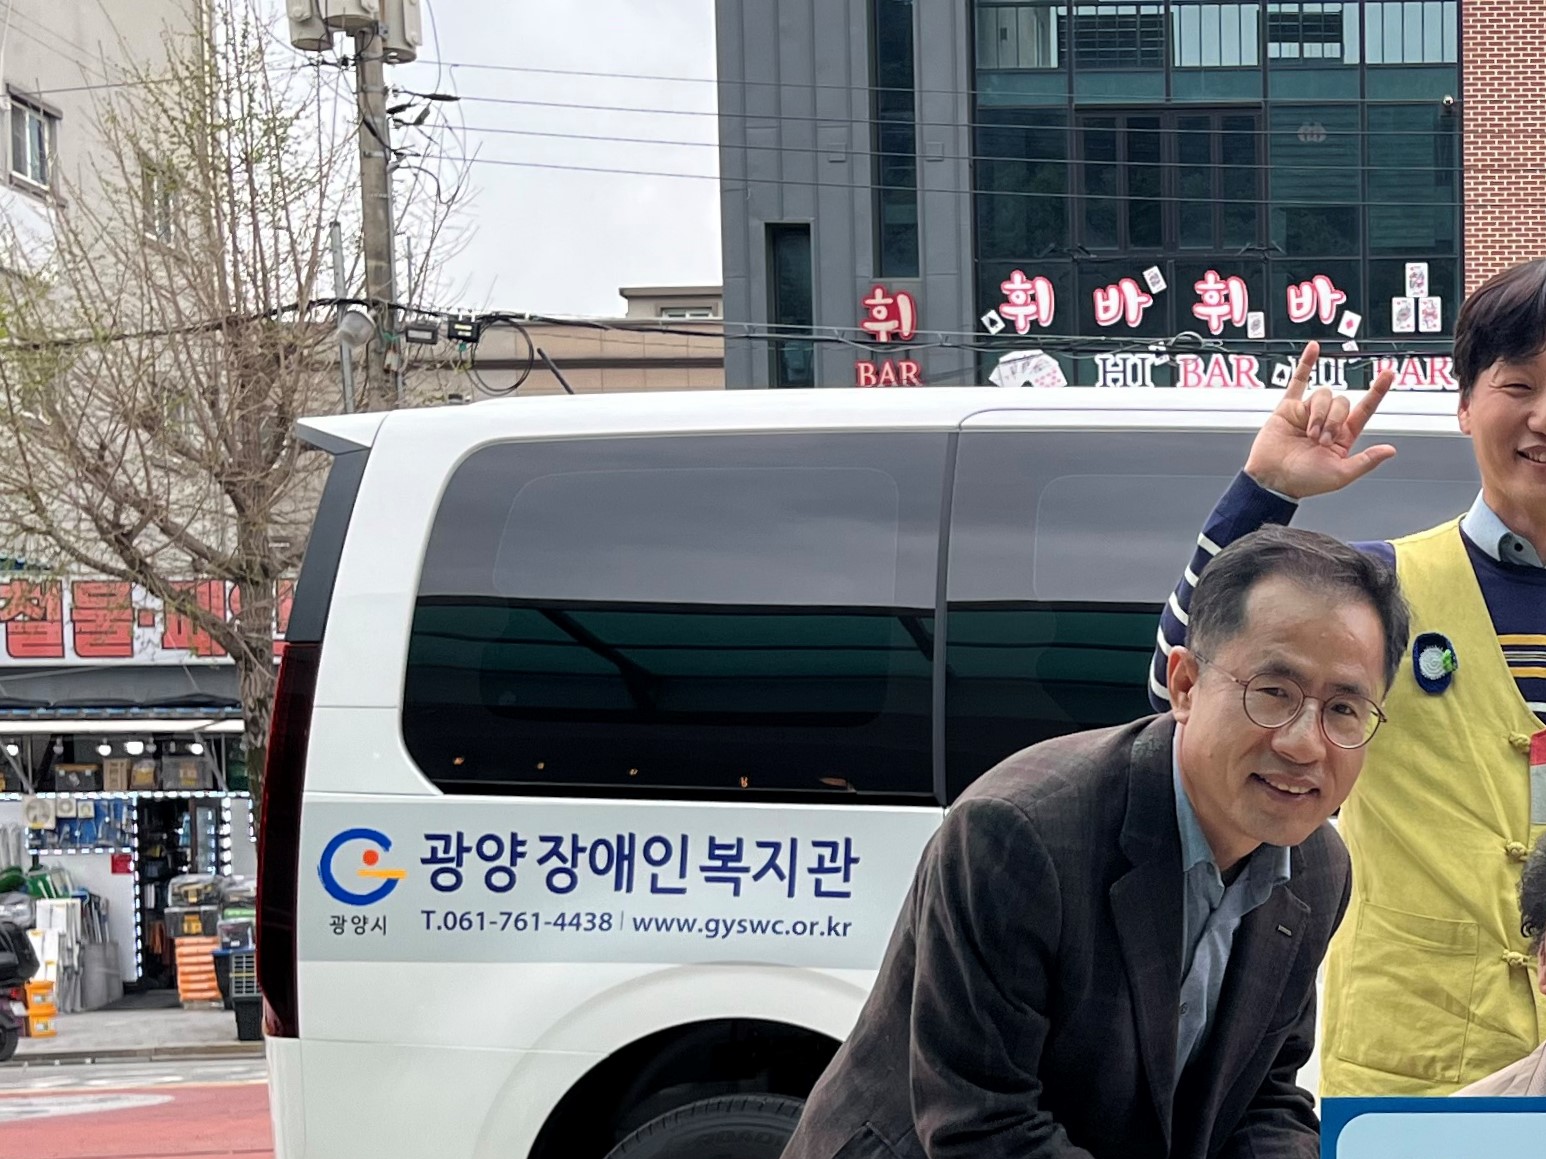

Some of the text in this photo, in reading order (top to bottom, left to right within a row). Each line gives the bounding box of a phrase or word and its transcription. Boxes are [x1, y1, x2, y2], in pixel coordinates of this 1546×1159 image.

[861, 285, 916, 341] 휘
[856, 360, 922, 387] BAR
[1095, 354, 1152, 387] HI
[1176, 353, 1265, 388] BAR
[1371, 356, 1454, 390] BAR
[329, 914, 388, 936] 광양시
[420, 910, 853, 938] T.061-761-4438 www.gyswc.or.kr
